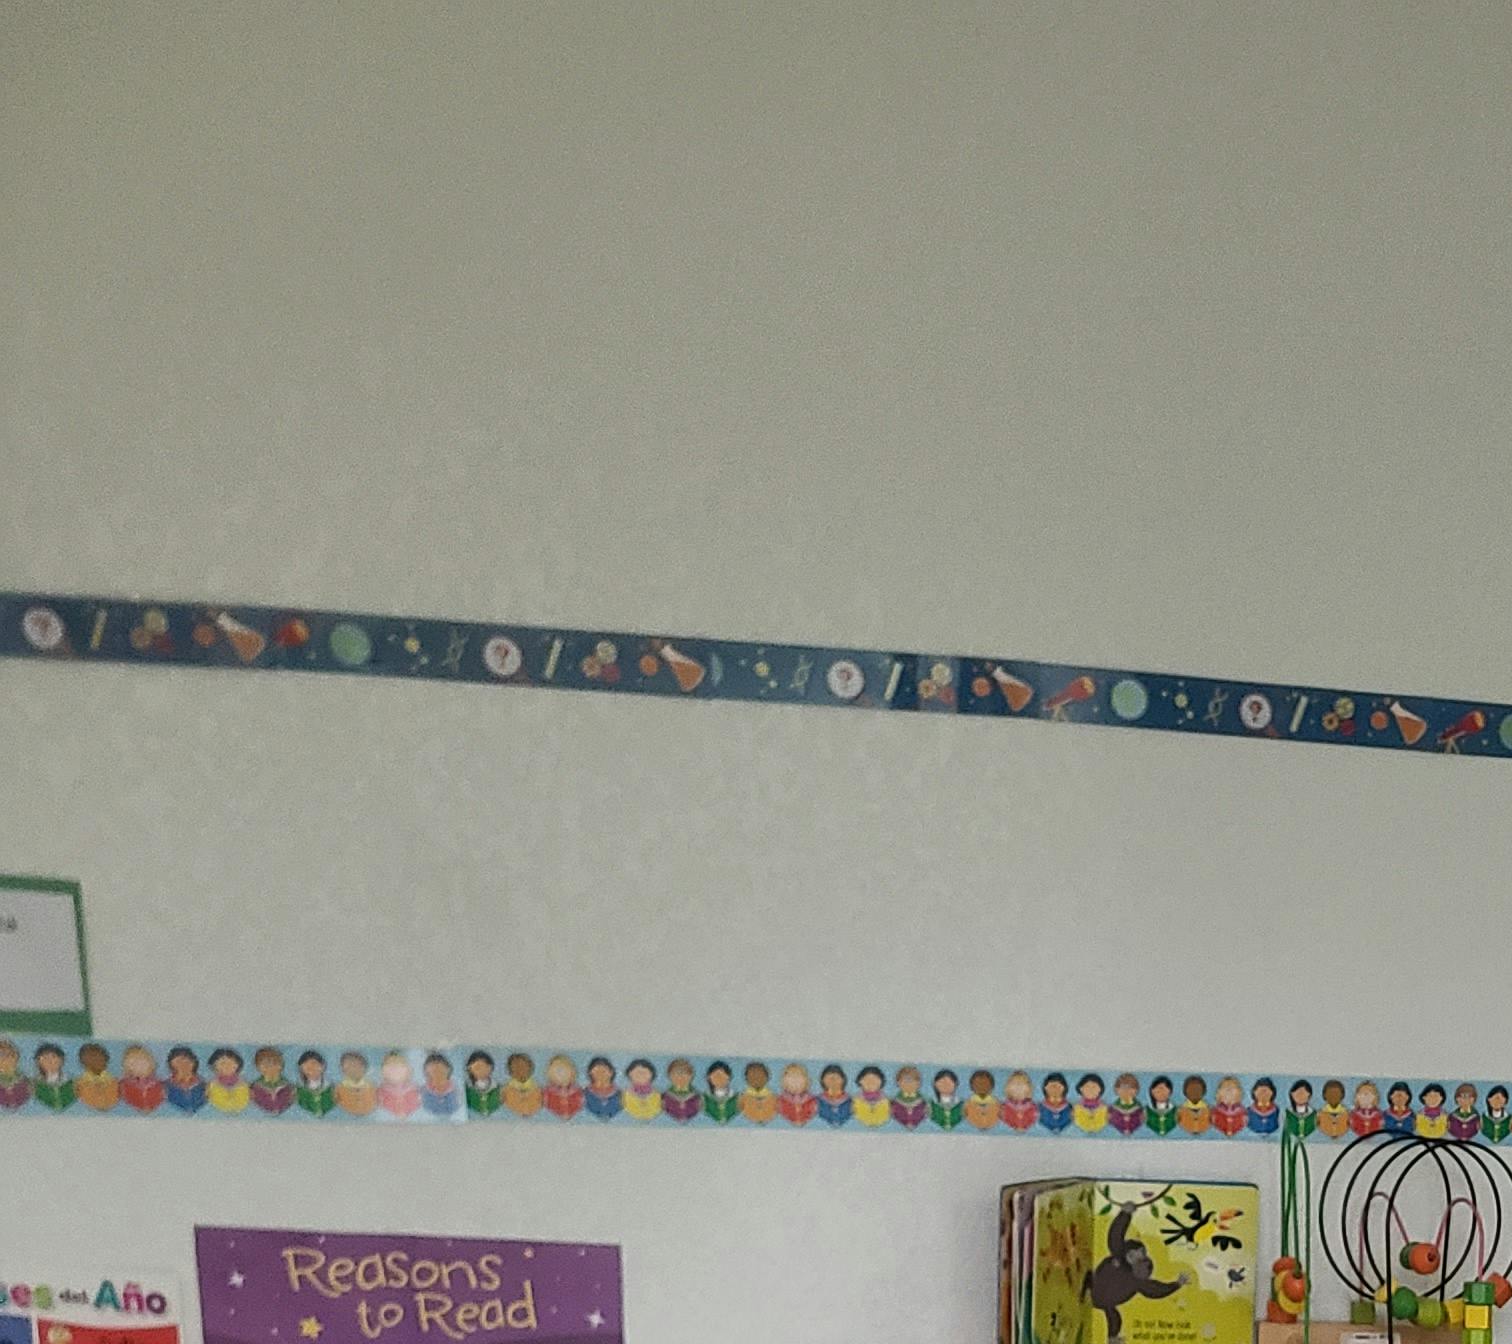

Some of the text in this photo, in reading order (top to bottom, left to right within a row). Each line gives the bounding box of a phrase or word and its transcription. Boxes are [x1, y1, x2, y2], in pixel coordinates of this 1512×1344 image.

[93, 1278, 168, 1315] Año
[282, 1246, 503, 1299] Reasons
[357, 1279, 538, 1340] to Read
